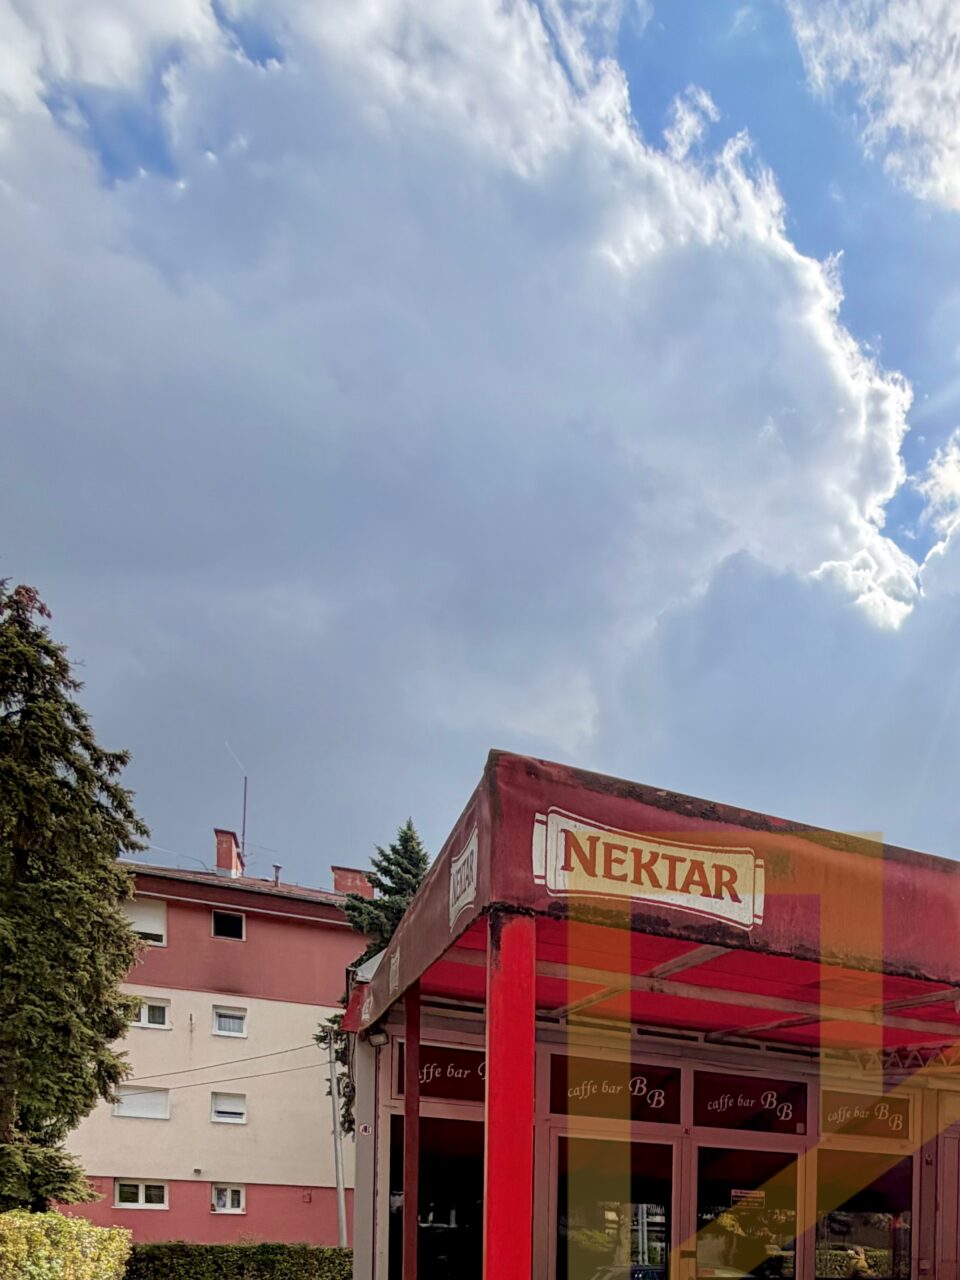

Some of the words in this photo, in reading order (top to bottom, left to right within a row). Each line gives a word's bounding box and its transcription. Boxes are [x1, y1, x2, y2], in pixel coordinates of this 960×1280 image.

[560, 828, 743, 904] NEKTAR
[446, 1063, 471, 1079] bar
[567, 1080, 598, 1100] caffe
[602, 1080, 624, 1095] bar
[707, 1094, 734, 1113] caffe
[737, 1094, 756, 1108] bar
[827, 1106, 851, 1123] caffe
[854, 1105, 870, 1119] bar
